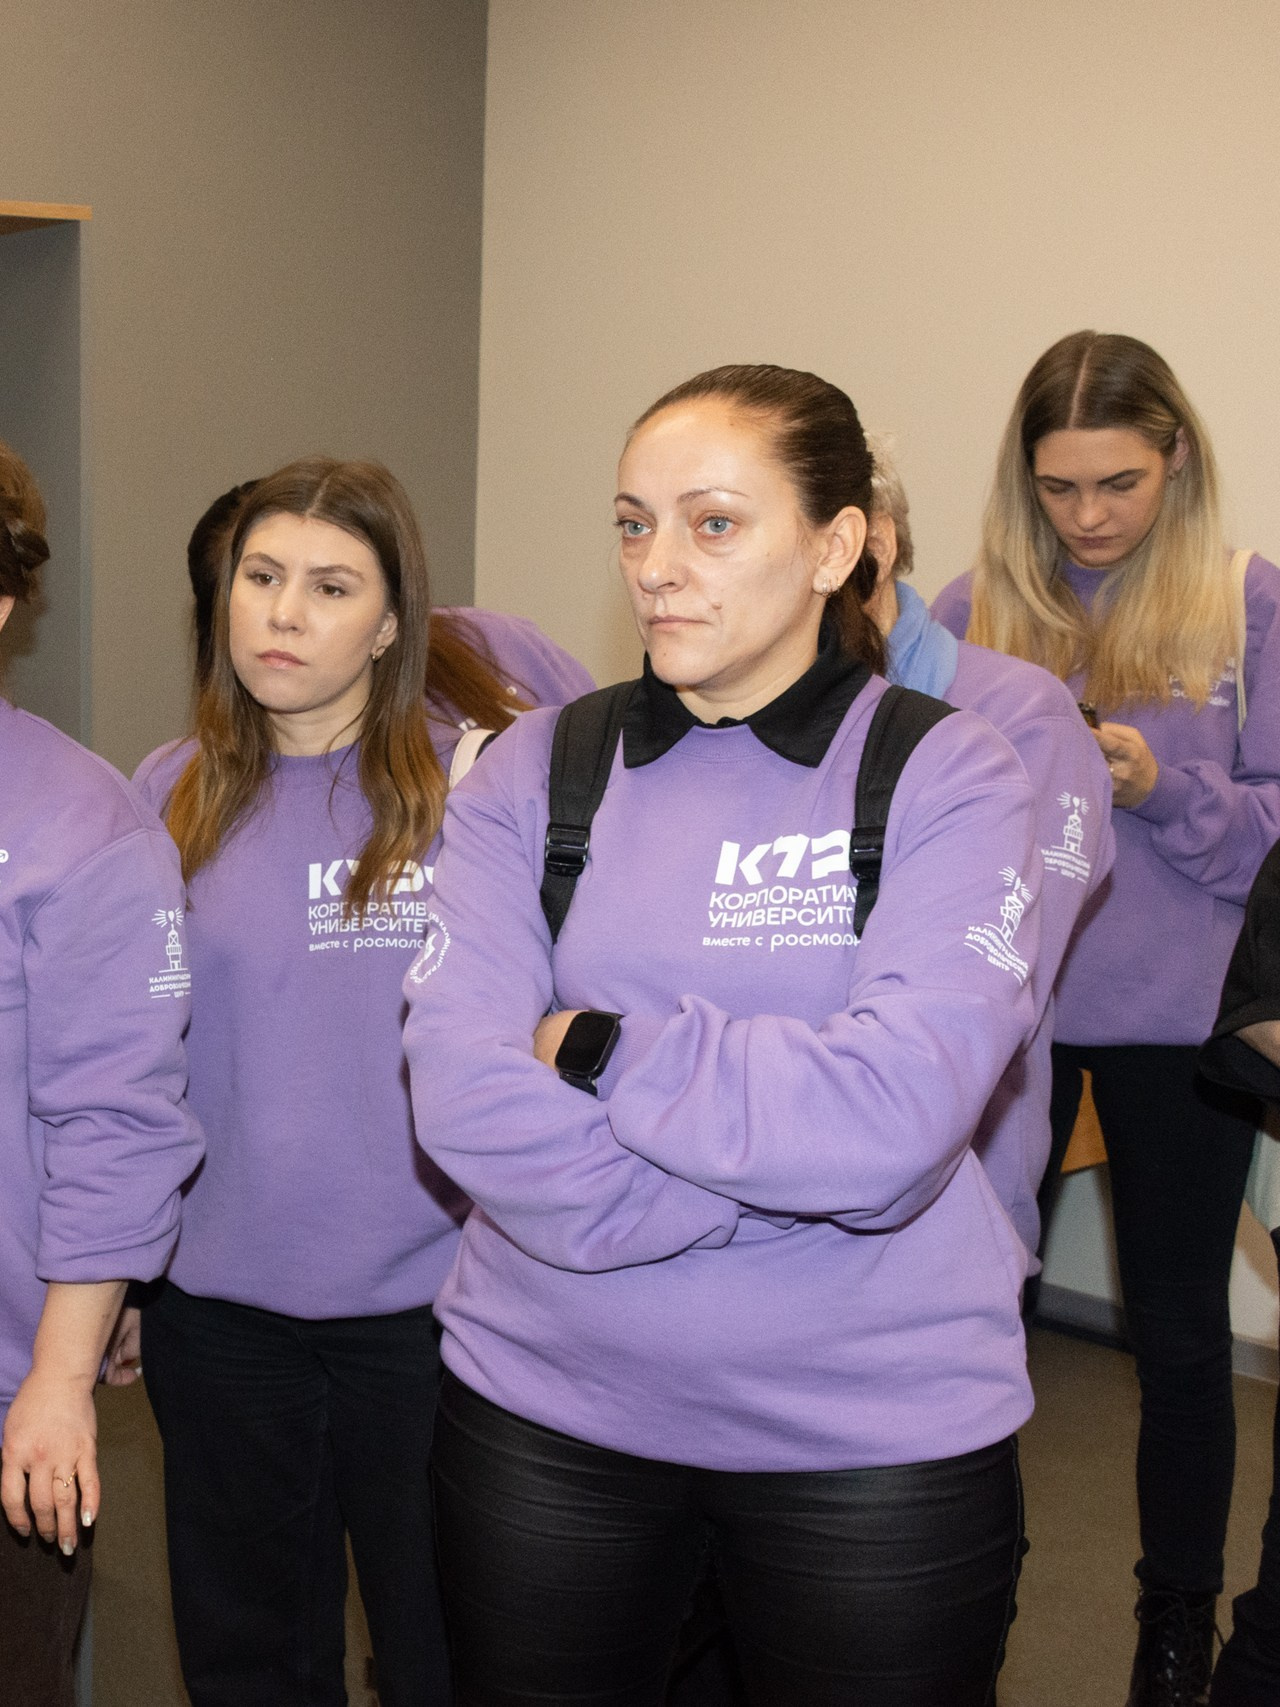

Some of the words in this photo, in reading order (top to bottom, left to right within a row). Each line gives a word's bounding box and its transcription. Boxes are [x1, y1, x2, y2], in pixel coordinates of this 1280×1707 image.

[309, 939, 341, 952] вместе
[343, 940, 349, 949] с
[703, 936, 750, 947] вместе
[755, 936, 764, 946] с
